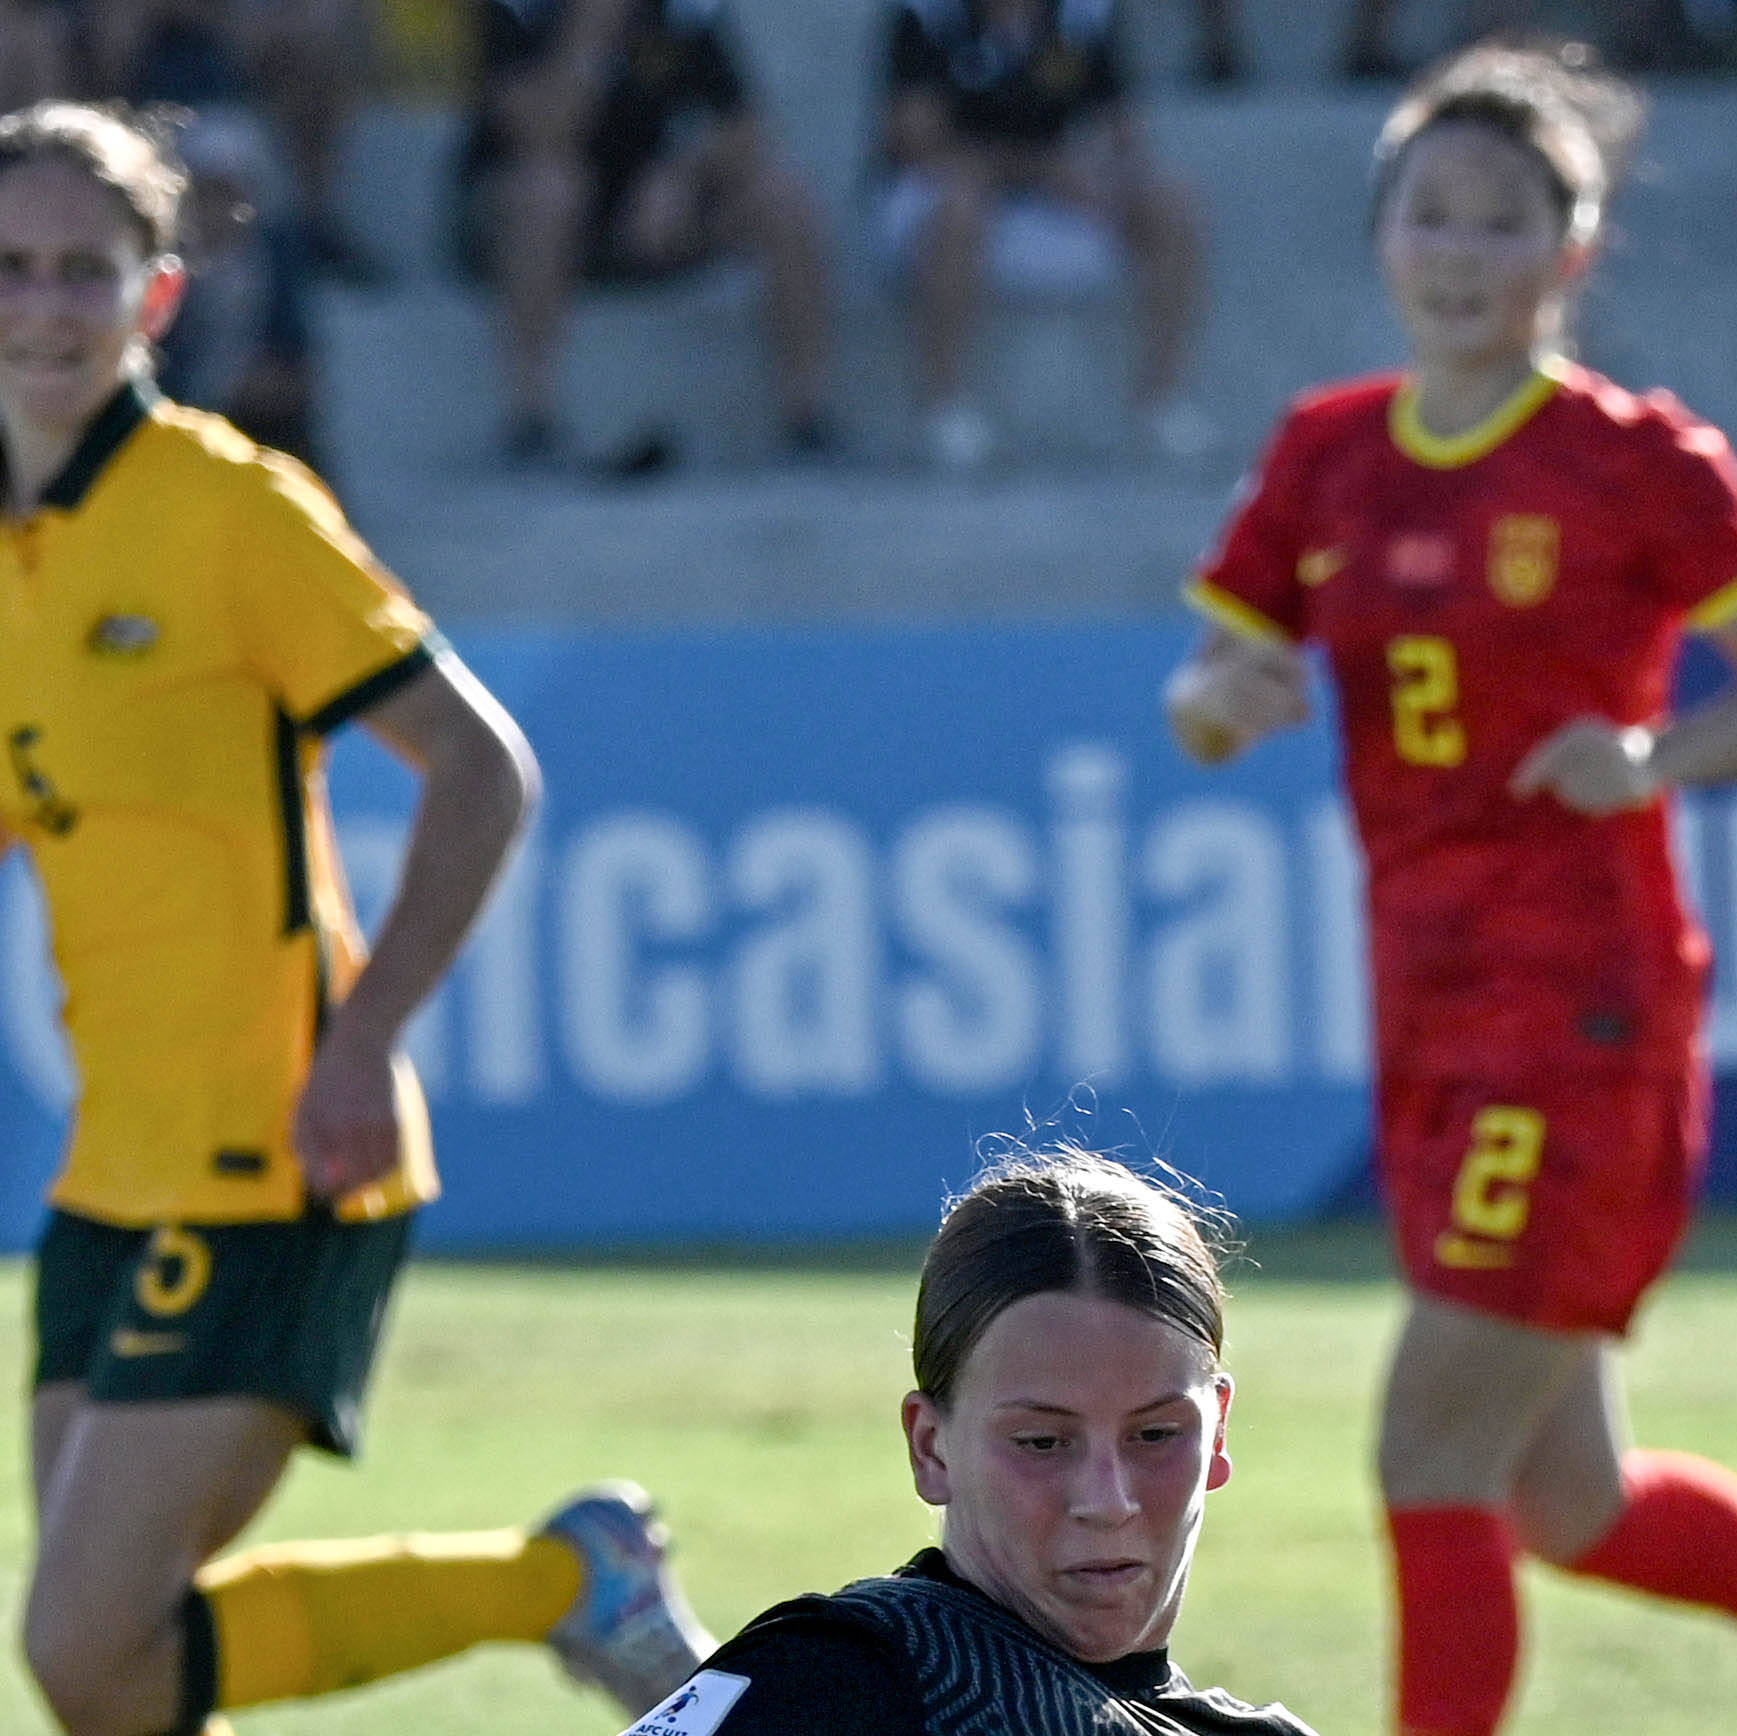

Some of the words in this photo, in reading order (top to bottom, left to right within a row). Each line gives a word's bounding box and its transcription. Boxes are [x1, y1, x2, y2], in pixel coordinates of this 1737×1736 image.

[1386, 635, 1465, 769] 2
[1453, 1105, 1546, 1241] 2
[637, 1724, 663, 1735] AFC
